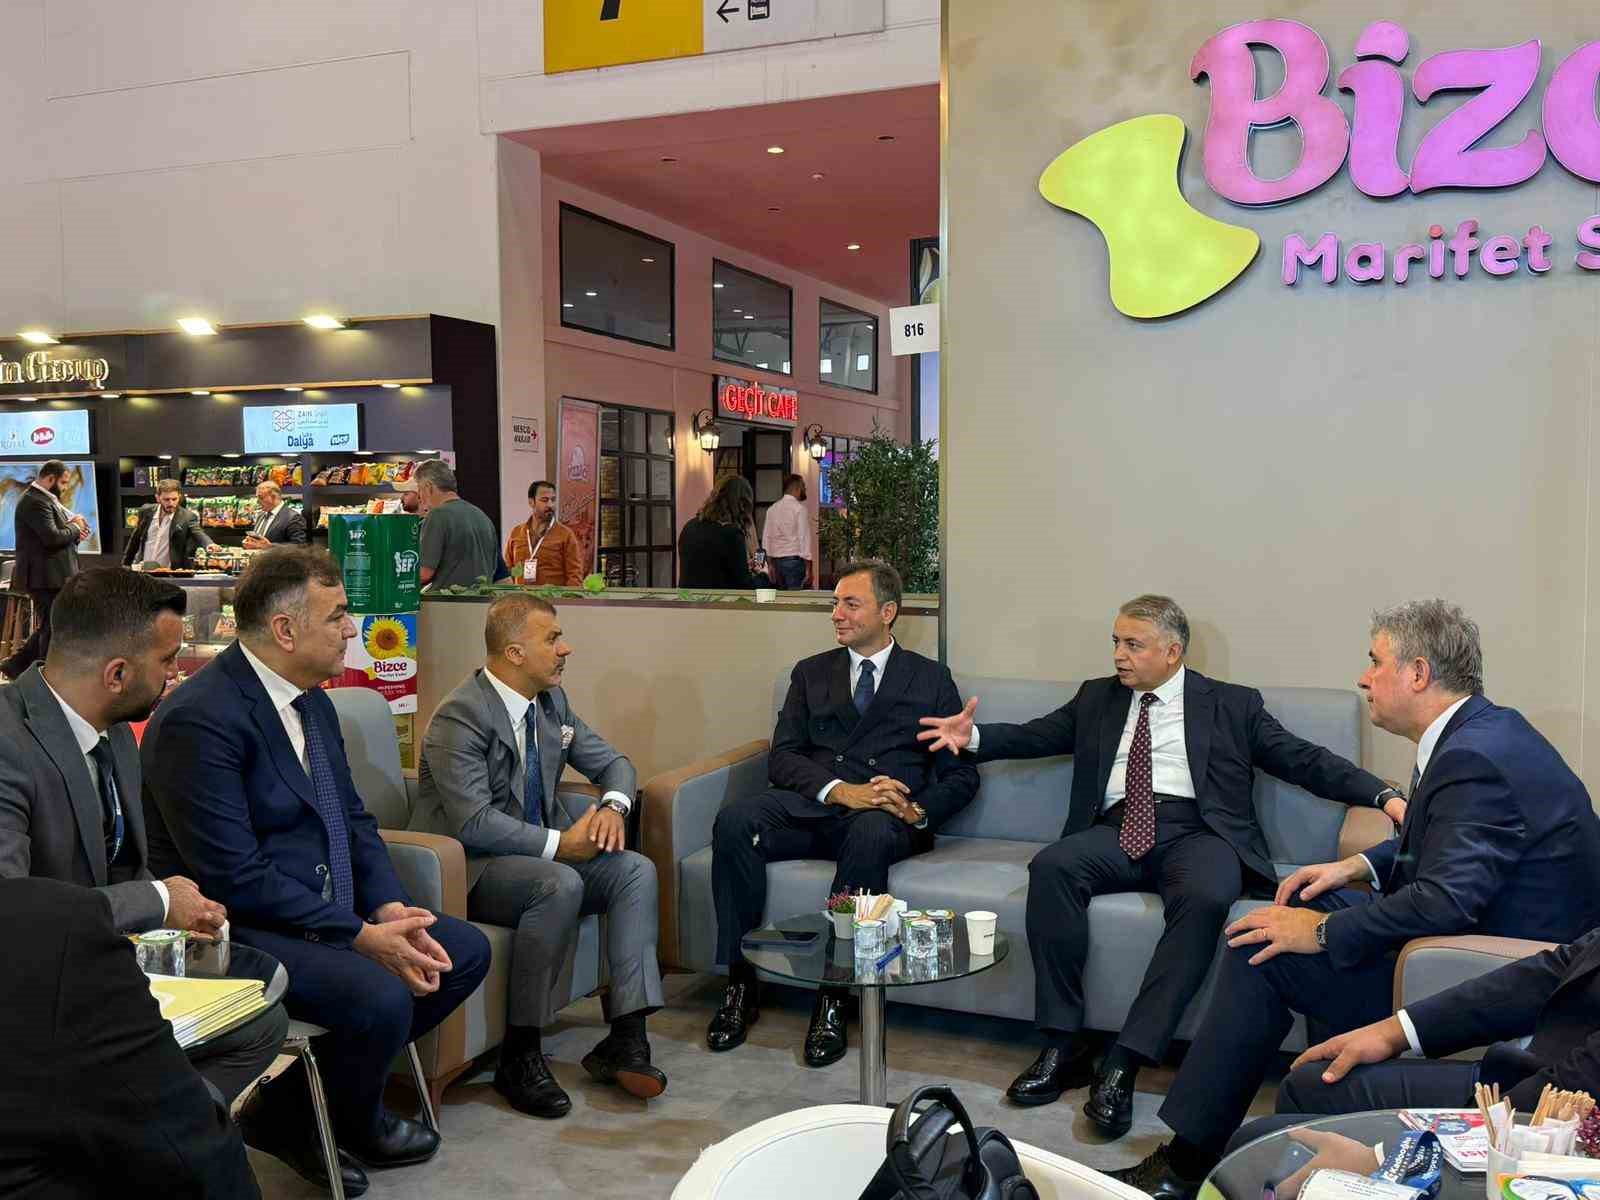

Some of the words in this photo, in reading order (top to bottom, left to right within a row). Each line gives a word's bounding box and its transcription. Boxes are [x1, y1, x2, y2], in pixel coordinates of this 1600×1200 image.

[1281, 218, 1551, 285] Marifet
[904, 322, 924, 337] 816
[24, 351, 109, 389] Group
[768, 392, 798, 420] CAFE
[287, 434, 314, 449] Dalya
[374, 661, 407, 673] Bizce
